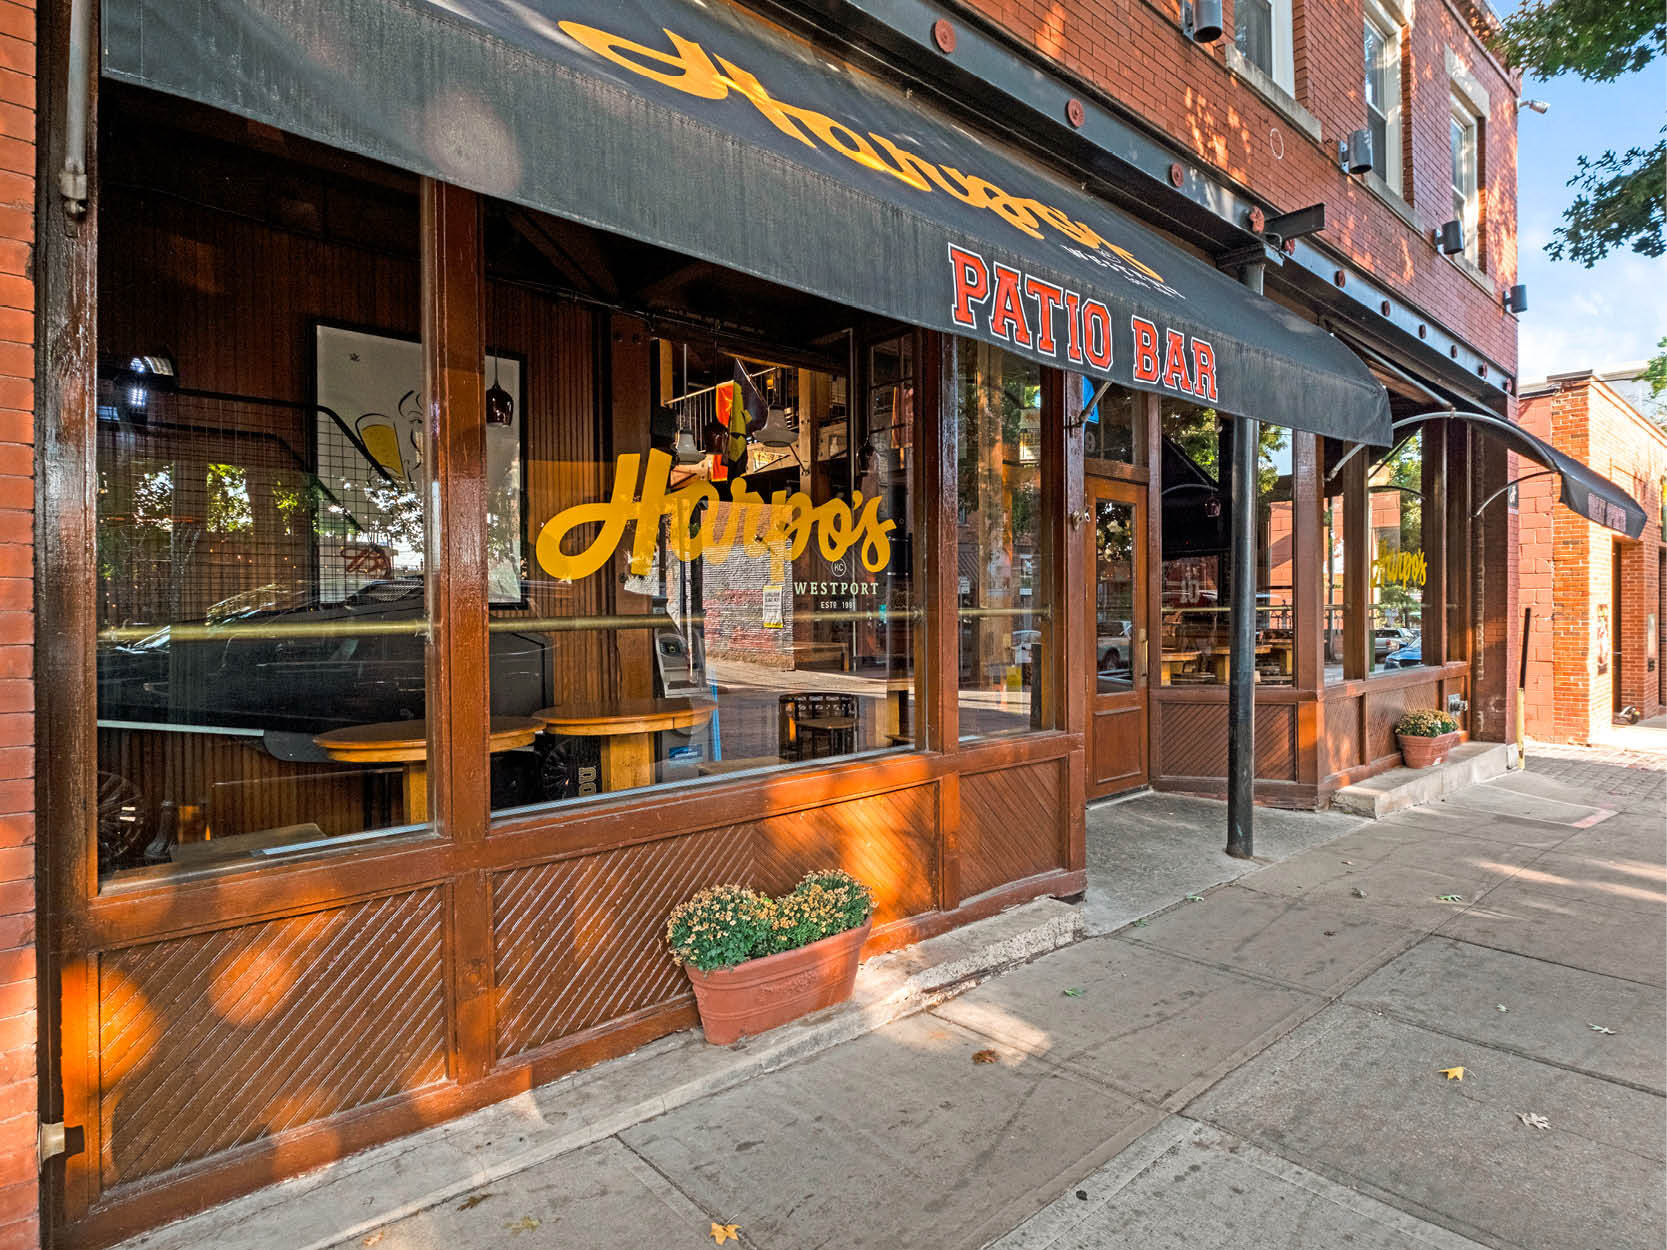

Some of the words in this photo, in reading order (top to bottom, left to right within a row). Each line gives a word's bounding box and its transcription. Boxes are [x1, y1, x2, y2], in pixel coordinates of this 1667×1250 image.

[948, 242, 1113, 372] PATIO
[1131, 315, 1218, 403] BAR
[536, 448, 897, 587] Harpo's
[793, 582, 879, 595] WESTPORT
